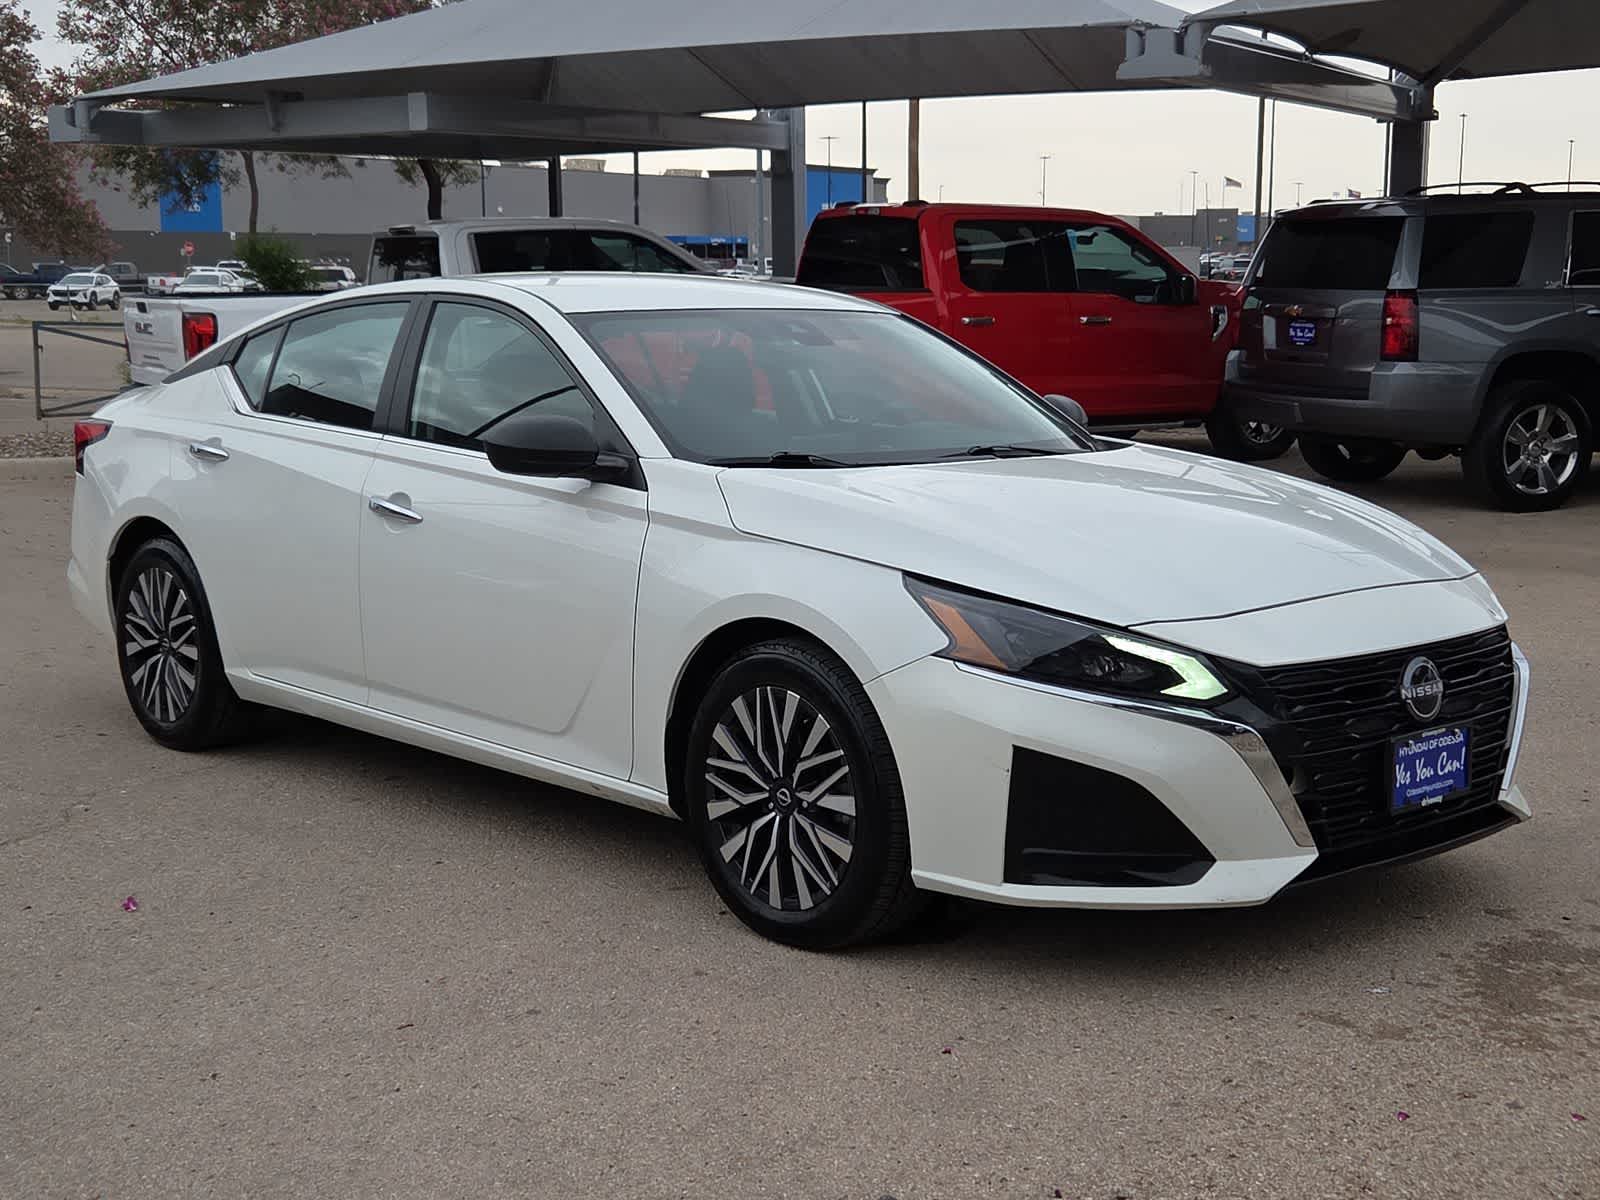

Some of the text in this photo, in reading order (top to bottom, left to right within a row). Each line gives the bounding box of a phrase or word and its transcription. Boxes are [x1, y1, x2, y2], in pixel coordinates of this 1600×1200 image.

[1396, 745, 1466, 788] Yes You Can!
